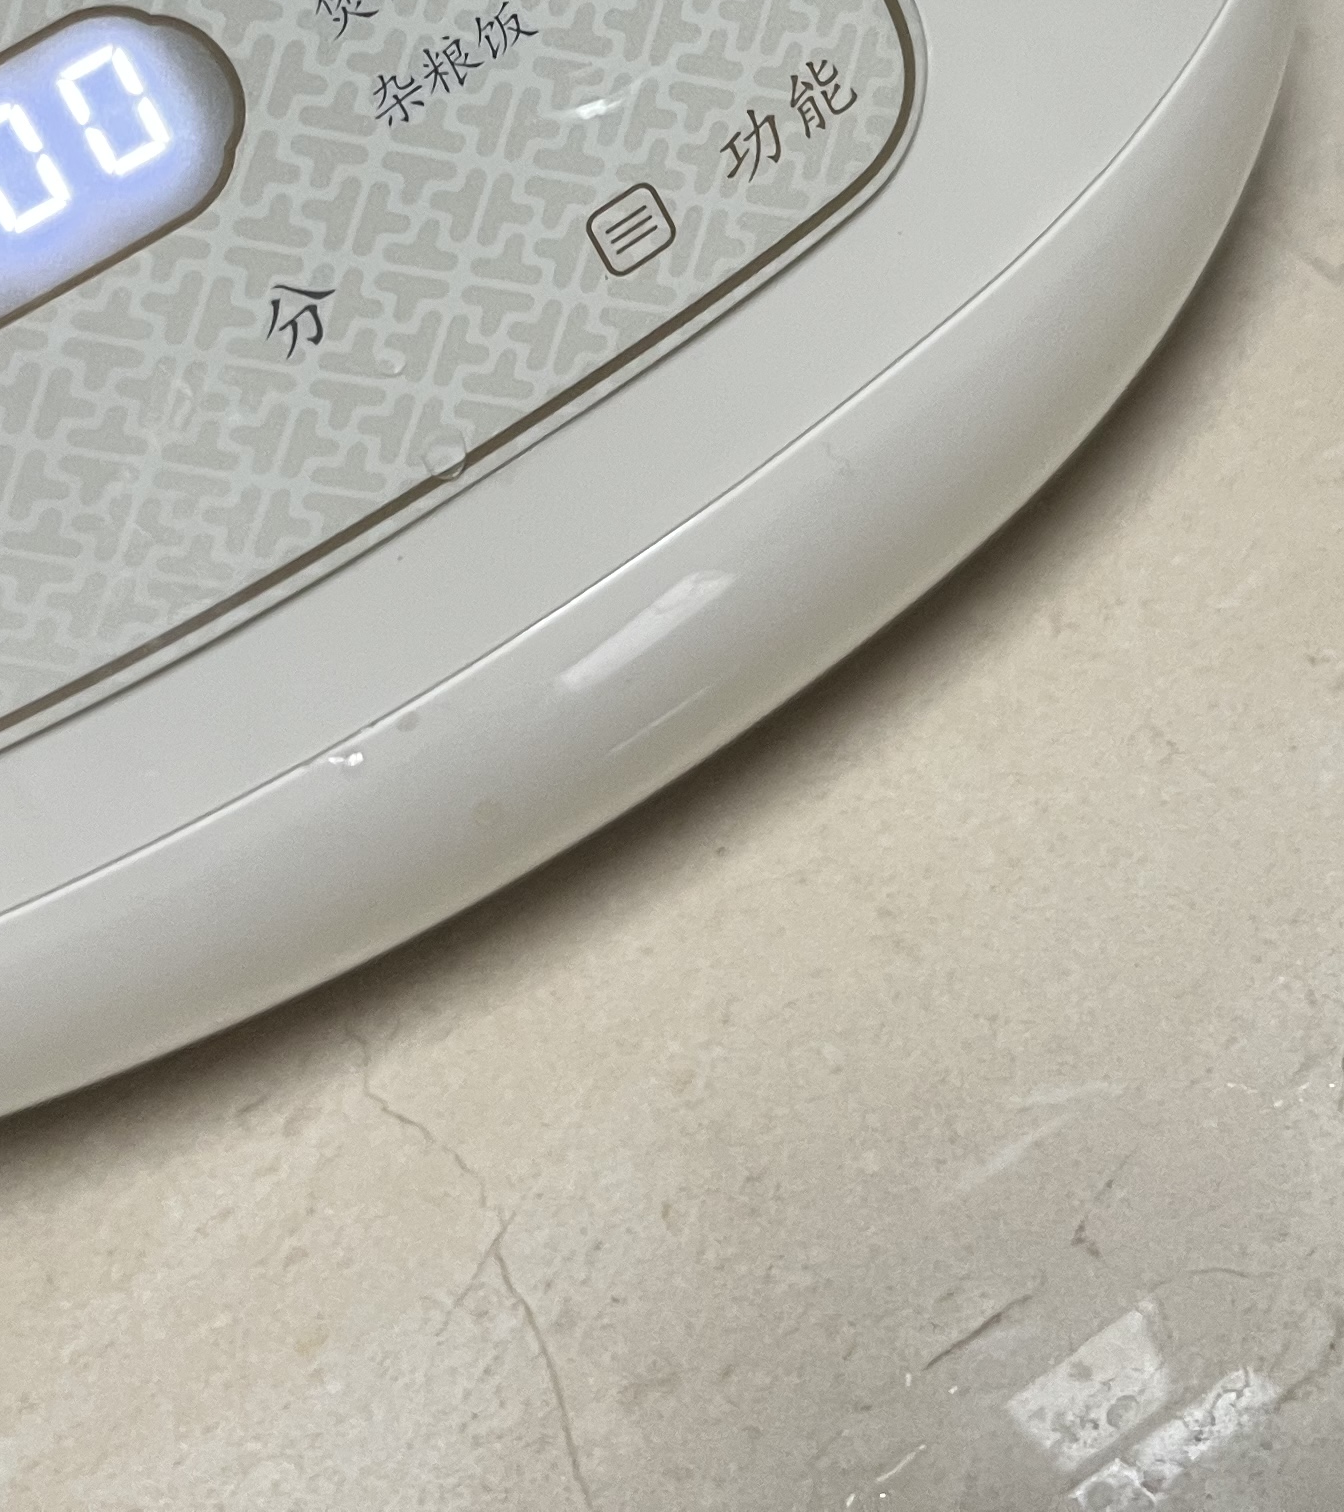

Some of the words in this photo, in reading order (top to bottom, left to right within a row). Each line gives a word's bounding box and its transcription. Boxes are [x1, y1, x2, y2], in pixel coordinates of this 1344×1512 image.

[372, 1, 538, 127] 杂粮饭
[719, 60, 858, 183] 功能
[266, 284, 336, 359] 分
